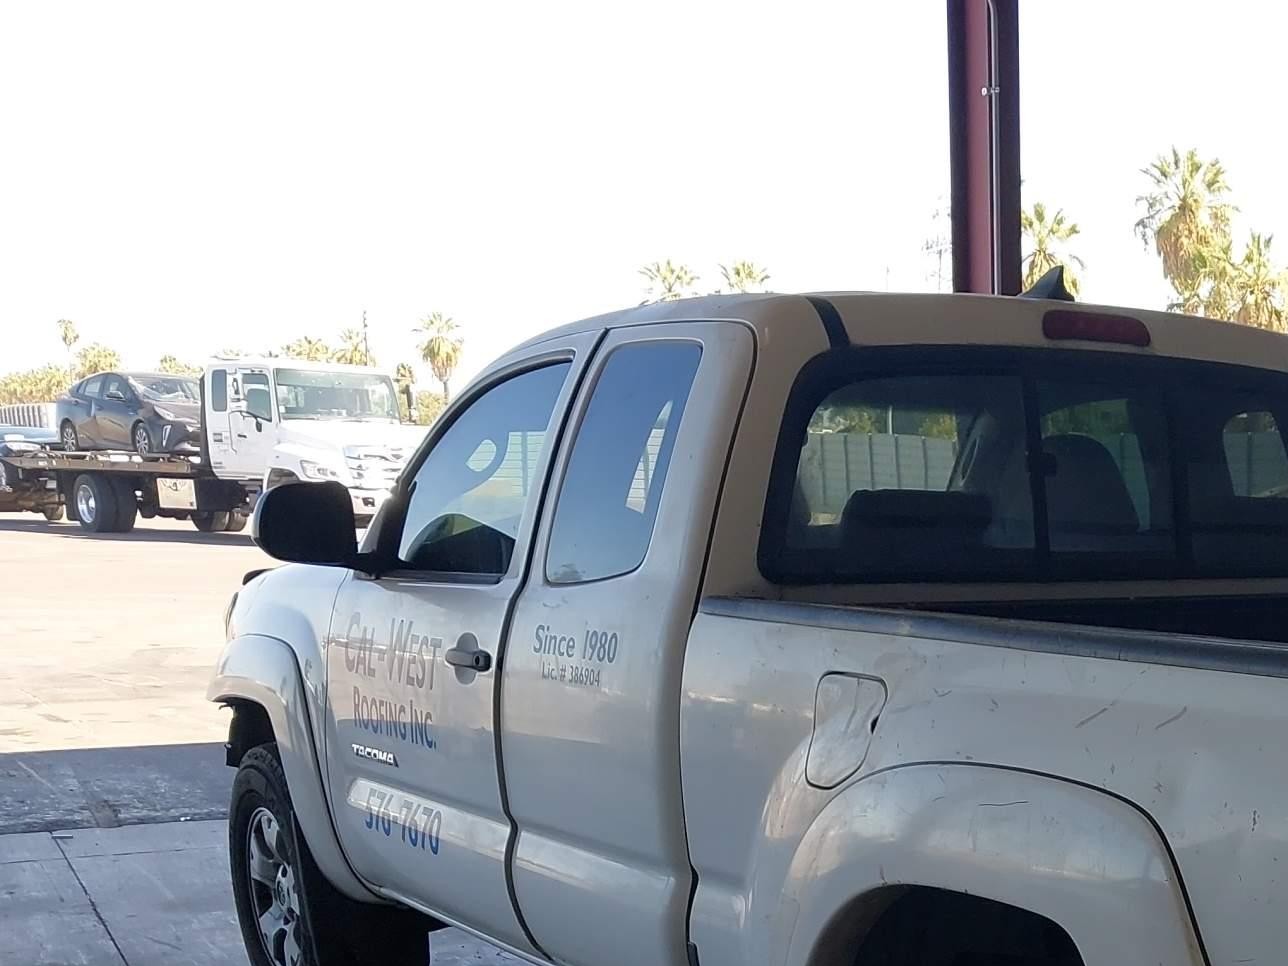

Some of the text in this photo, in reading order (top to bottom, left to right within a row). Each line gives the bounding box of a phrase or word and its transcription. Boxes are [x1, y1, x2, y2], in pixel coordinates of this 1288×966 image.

[533, 624, 618, 663] Since 1980
[541, 661, 600, 687] Lic. # 386904
[353, 686, 406, 740] ROOFING
[352, 743, 398, 768] TACOMA
[364, 788, 442, 856] 576-7670
